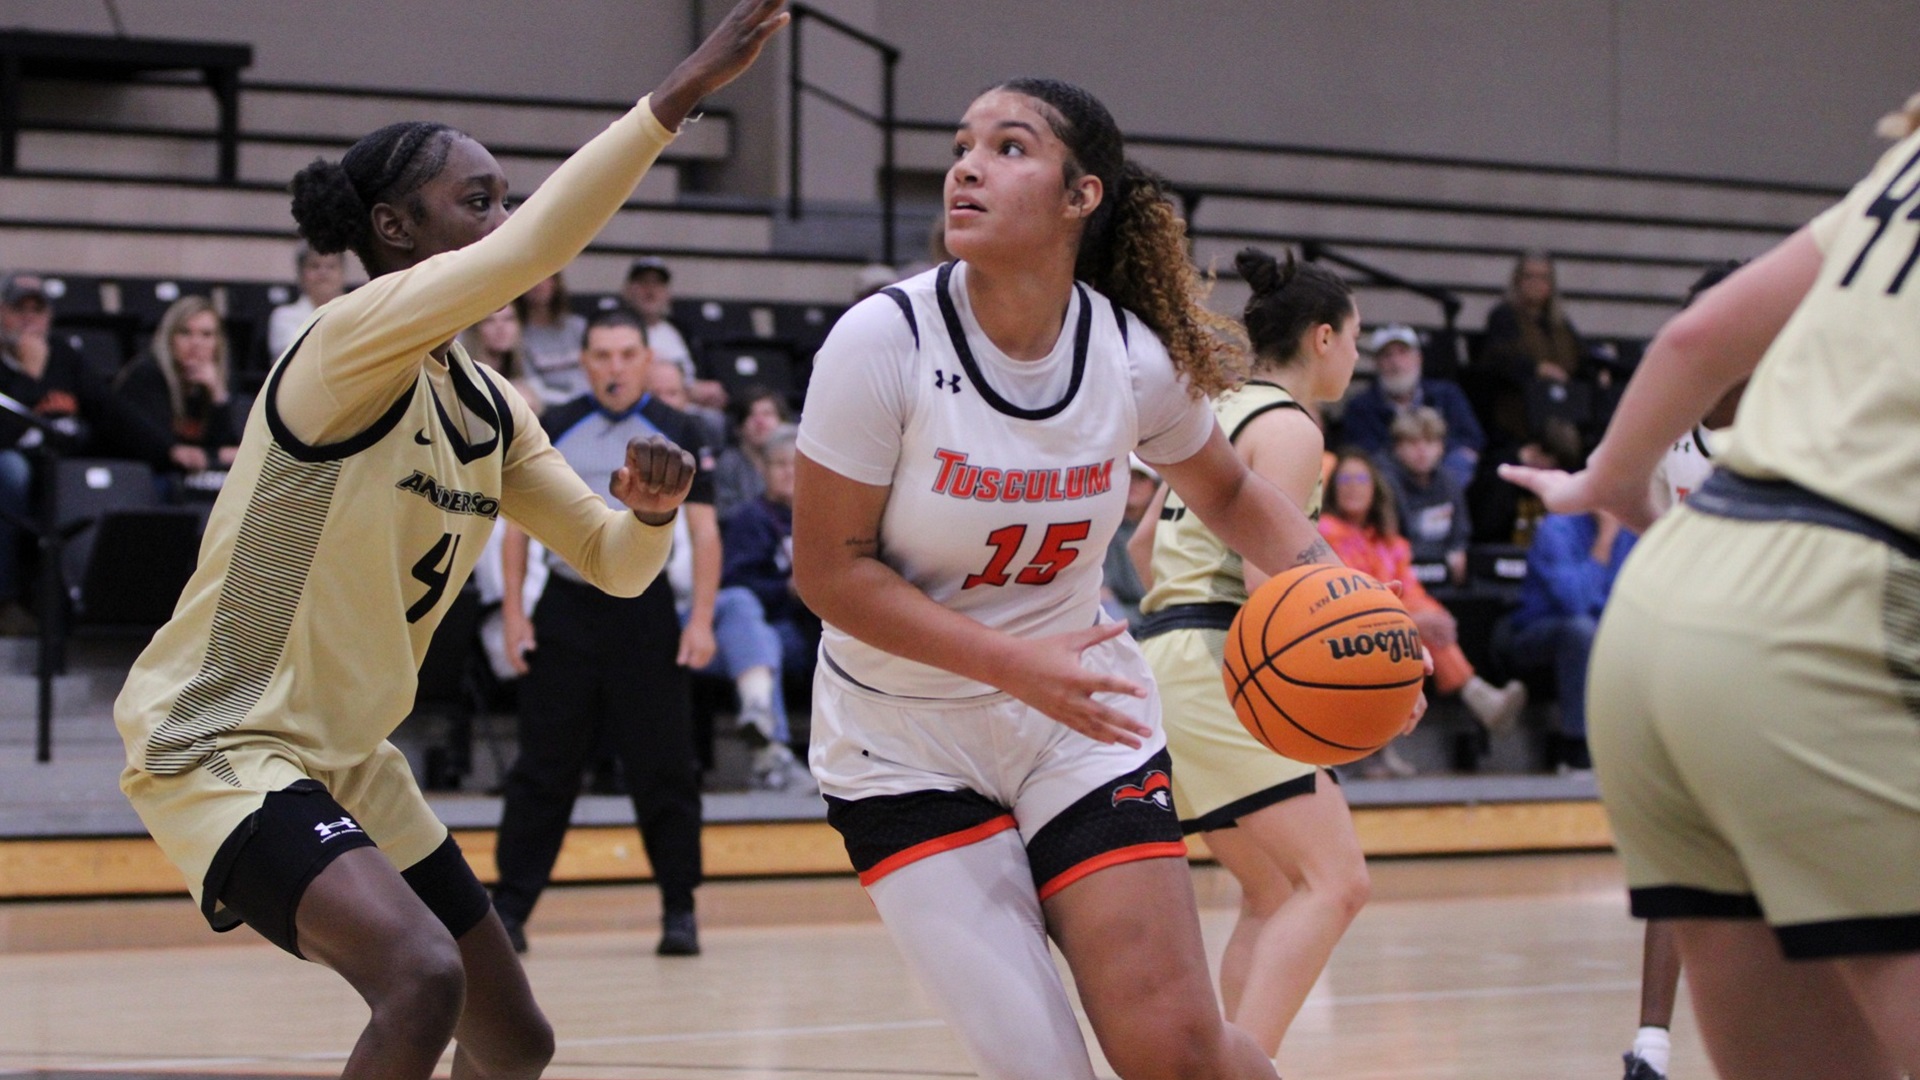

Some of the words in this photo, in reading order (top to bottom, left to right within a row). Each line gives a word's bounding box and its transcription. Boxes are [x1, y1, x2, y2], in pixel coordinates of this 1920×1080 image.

[931, 448, 1115, 502] TUSCULUM
[406, 532, 461, 624] 4
[961, 519, 1092, 590] 15
